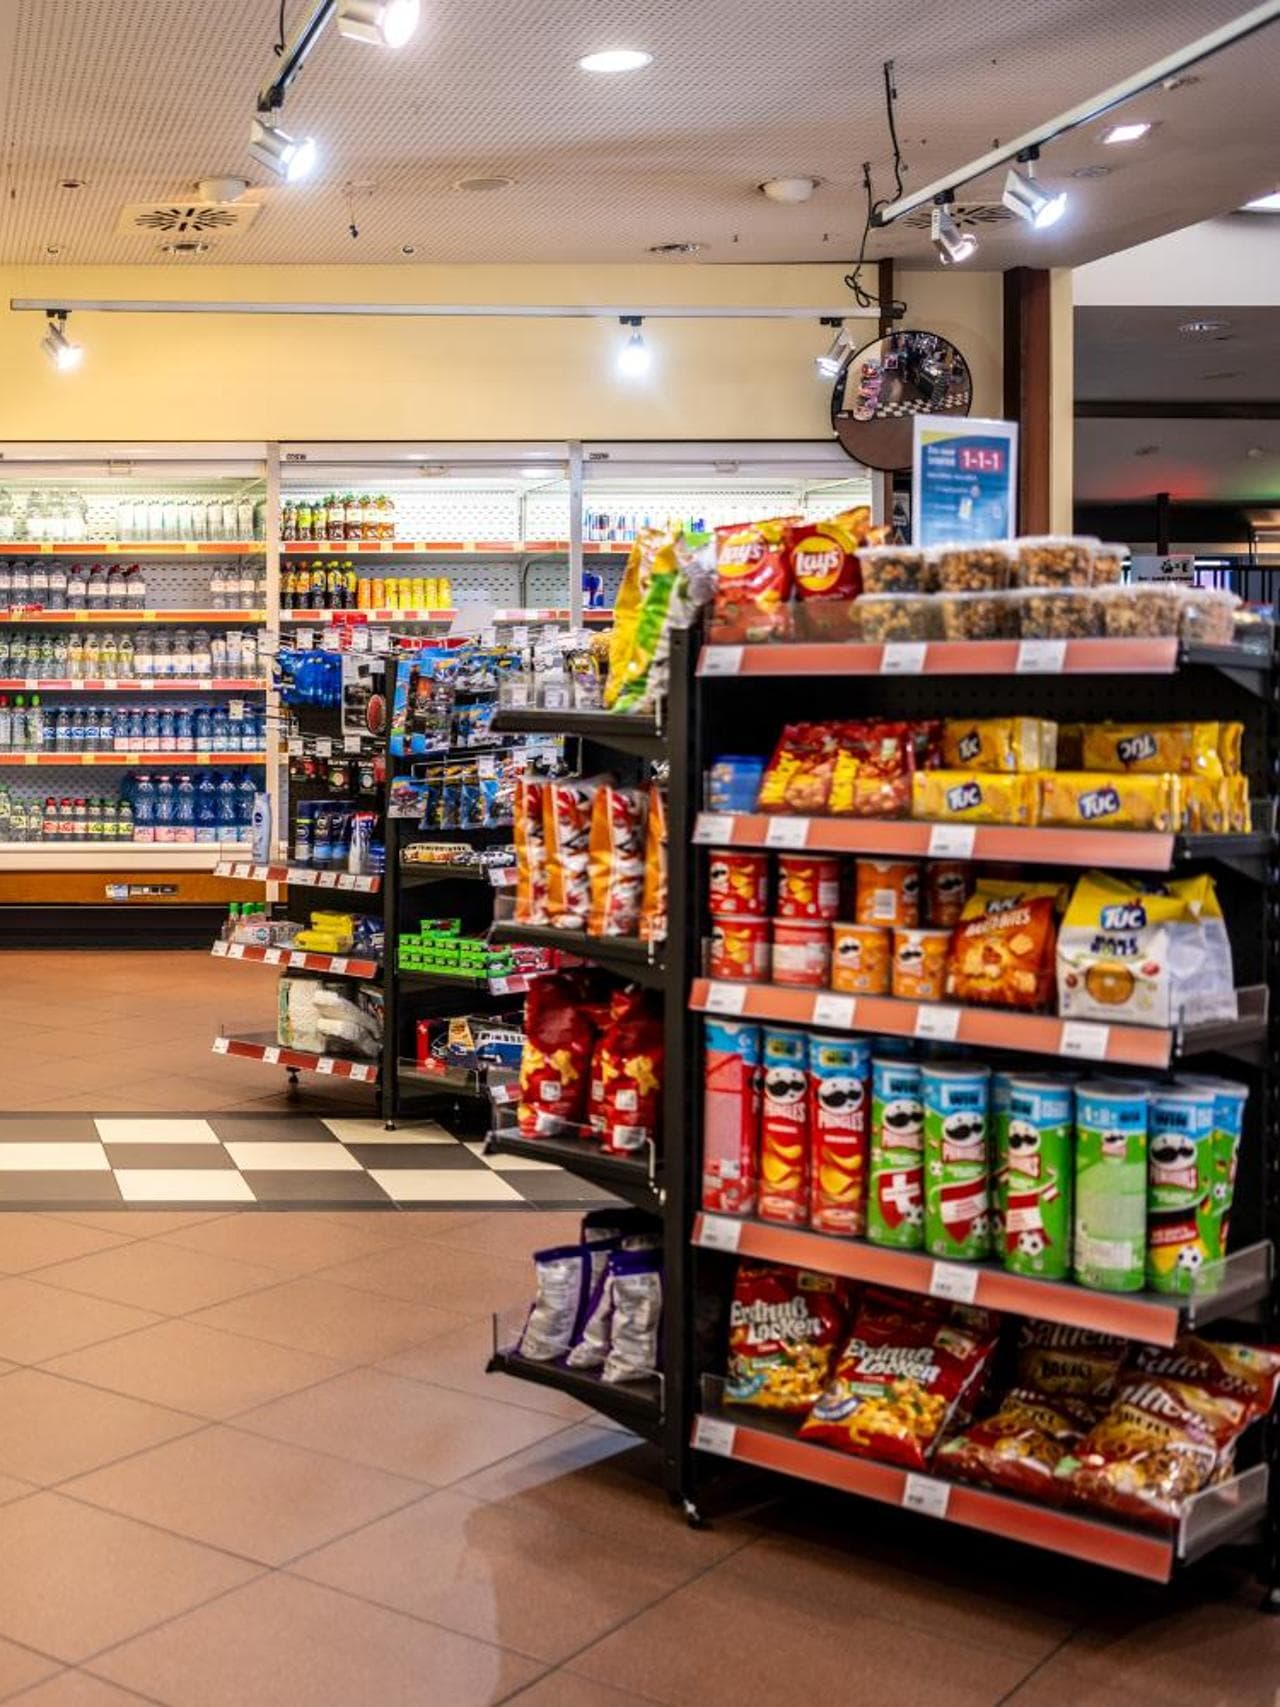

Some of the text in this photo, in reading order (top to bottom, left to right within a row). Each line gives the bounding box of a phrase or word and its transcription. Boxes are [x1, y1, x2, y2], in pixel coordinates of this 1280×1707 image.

[948, 785, 980, 808] TUC
[1081, 793, 1118, 817] TUC
[1105, 908, 1142, 929] TUC
